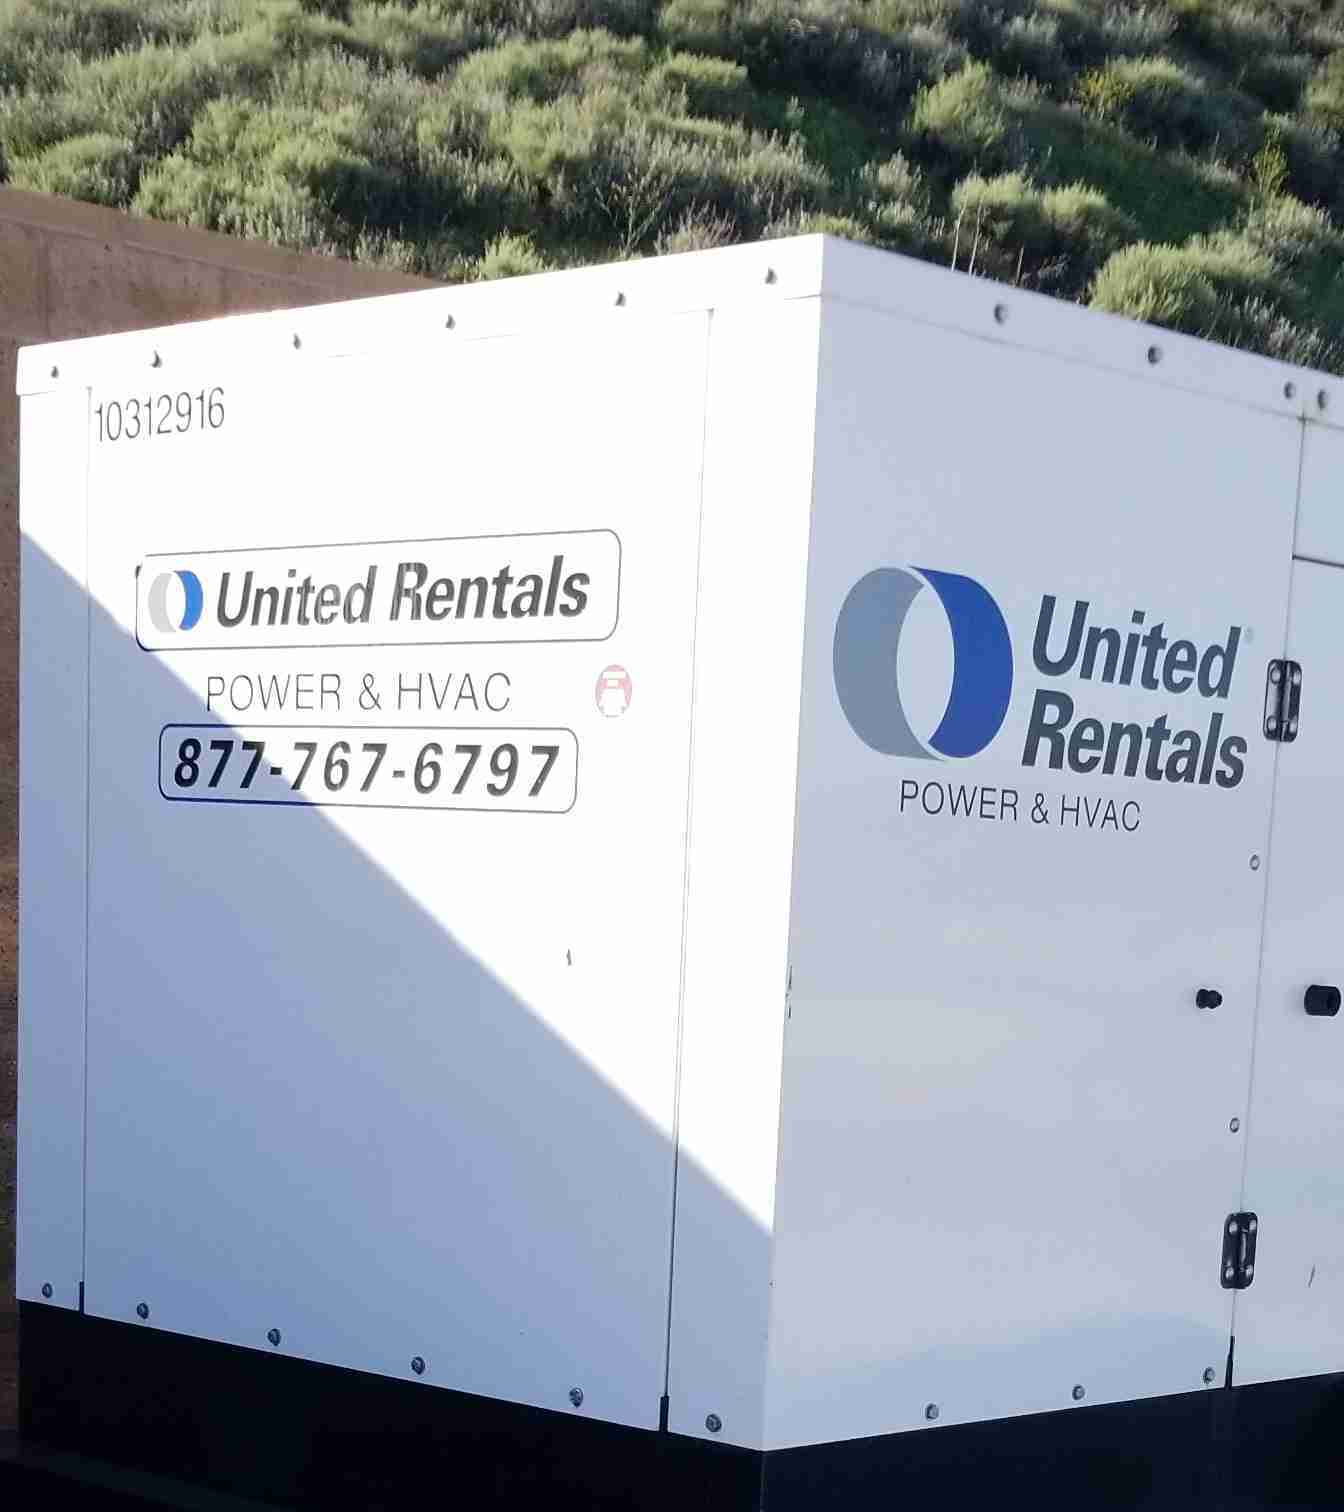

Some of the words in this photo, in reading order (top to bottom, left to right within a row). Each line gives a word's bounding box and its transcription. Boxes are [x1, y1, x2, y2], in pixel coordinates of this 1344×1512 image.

[94, 386, 226, 442] 10312916
[216, 563, 378, 628] United
[389, 554, 591, 623] Rentals
[1032, 594, 1242, 699] United
[206, 672, 342, 712] POWER
[358, 673, 382, 711] &
[396, 671, 512, 712] HVAC
[173, 737, 560, 798] 877-767-6797
[1021, 688, 1248, 789] Rentals
[899, 779, 1018, 822] POWER
[1031, 792, 1050, 824] &
[1060, 793, 1142, 832] HVAC
